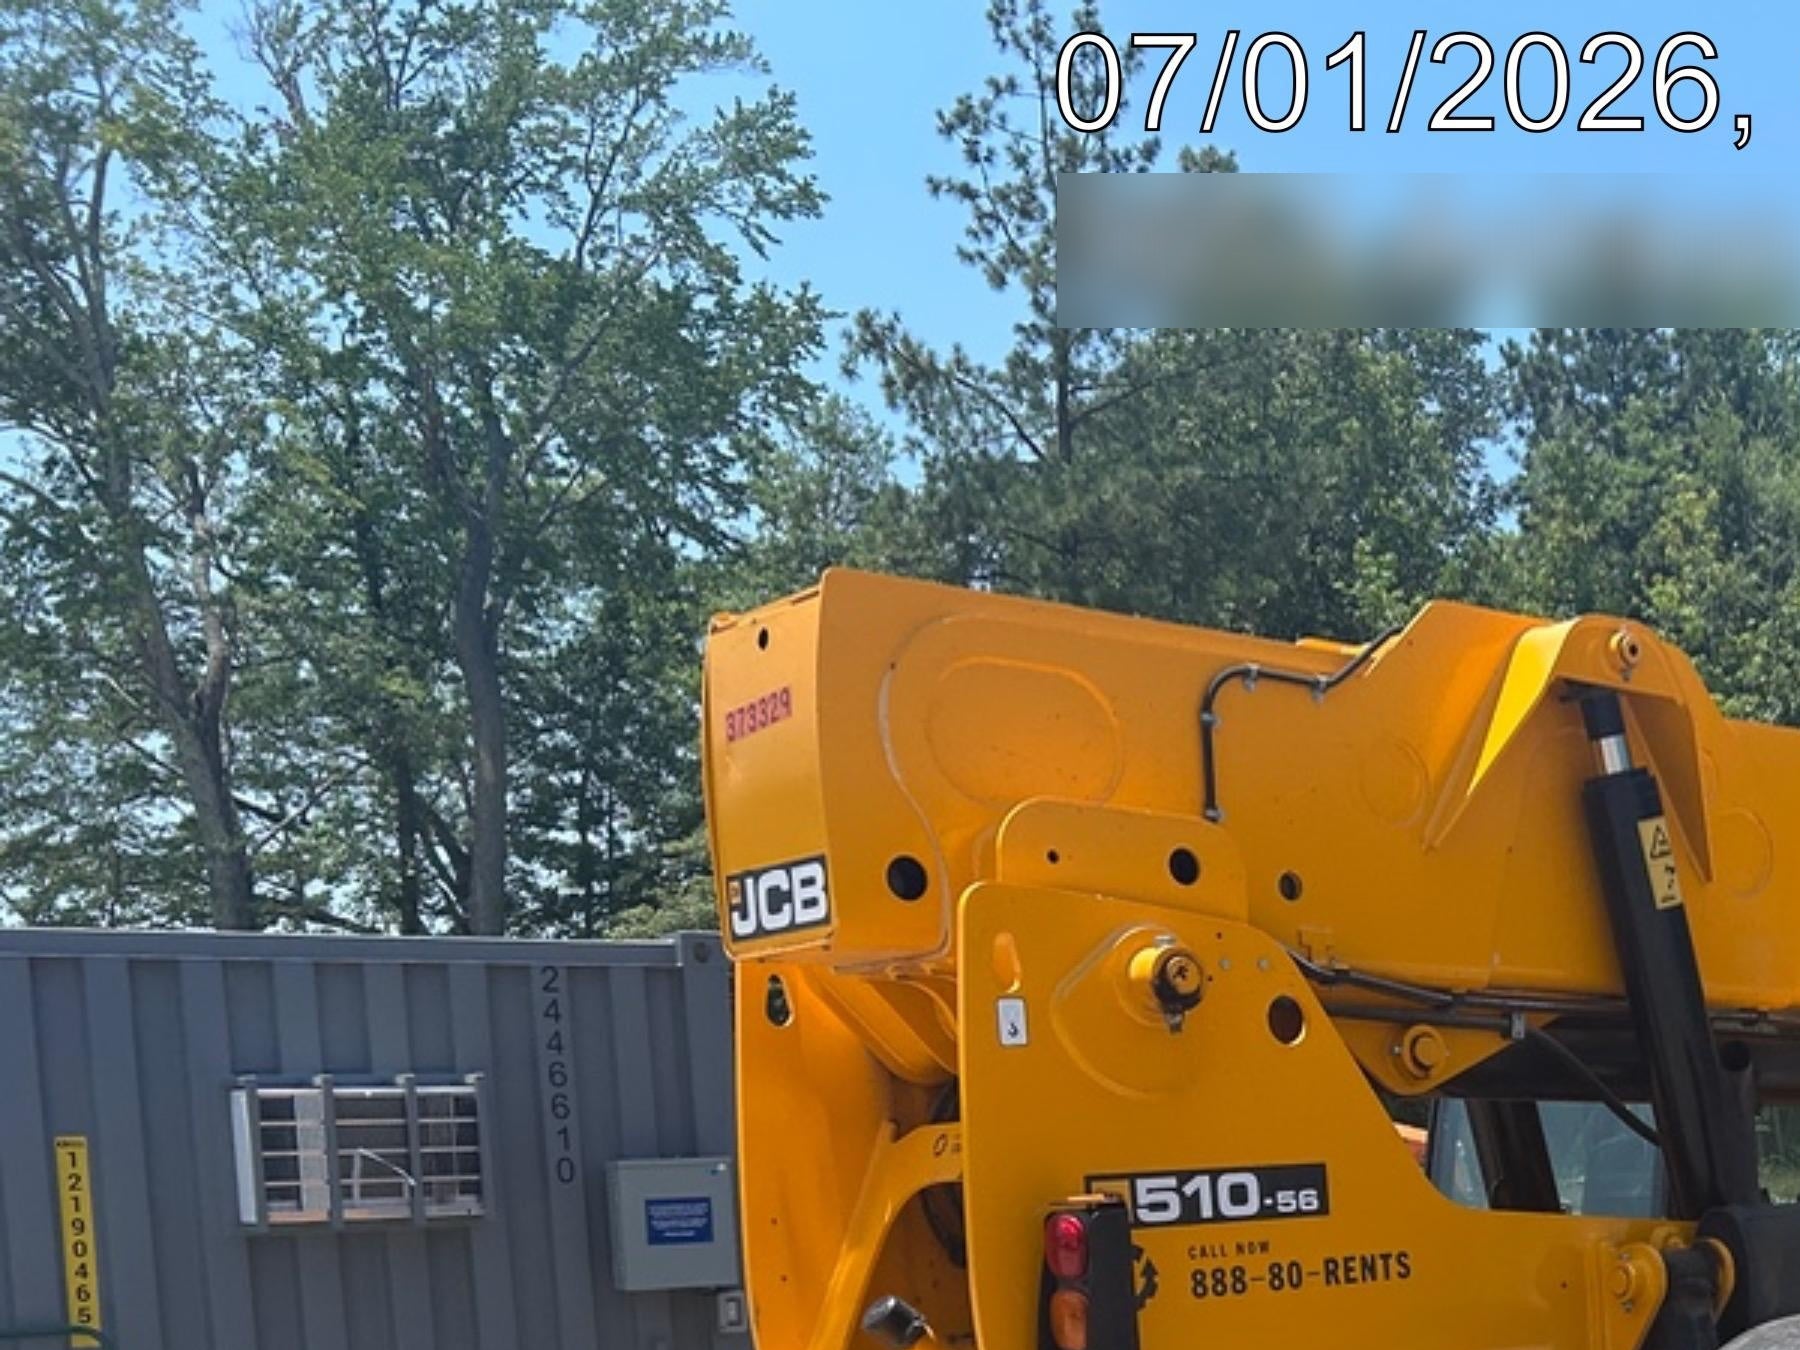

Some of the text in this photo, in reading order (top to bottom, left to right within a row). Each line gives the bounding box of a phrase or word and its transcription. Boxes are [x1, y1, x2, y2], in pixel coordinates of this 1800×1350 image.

[726, 687, 792, 743] 373329
[732, 861, 828, 937] JCB
[541, 966, 574, 1183] 2446610
[67, 1151, 92, 1324] 12190465
[1187, 1241, 1270, 1260] CALL NOW
[1191, 1251, 1411, 1299] 888-80-RENTS
